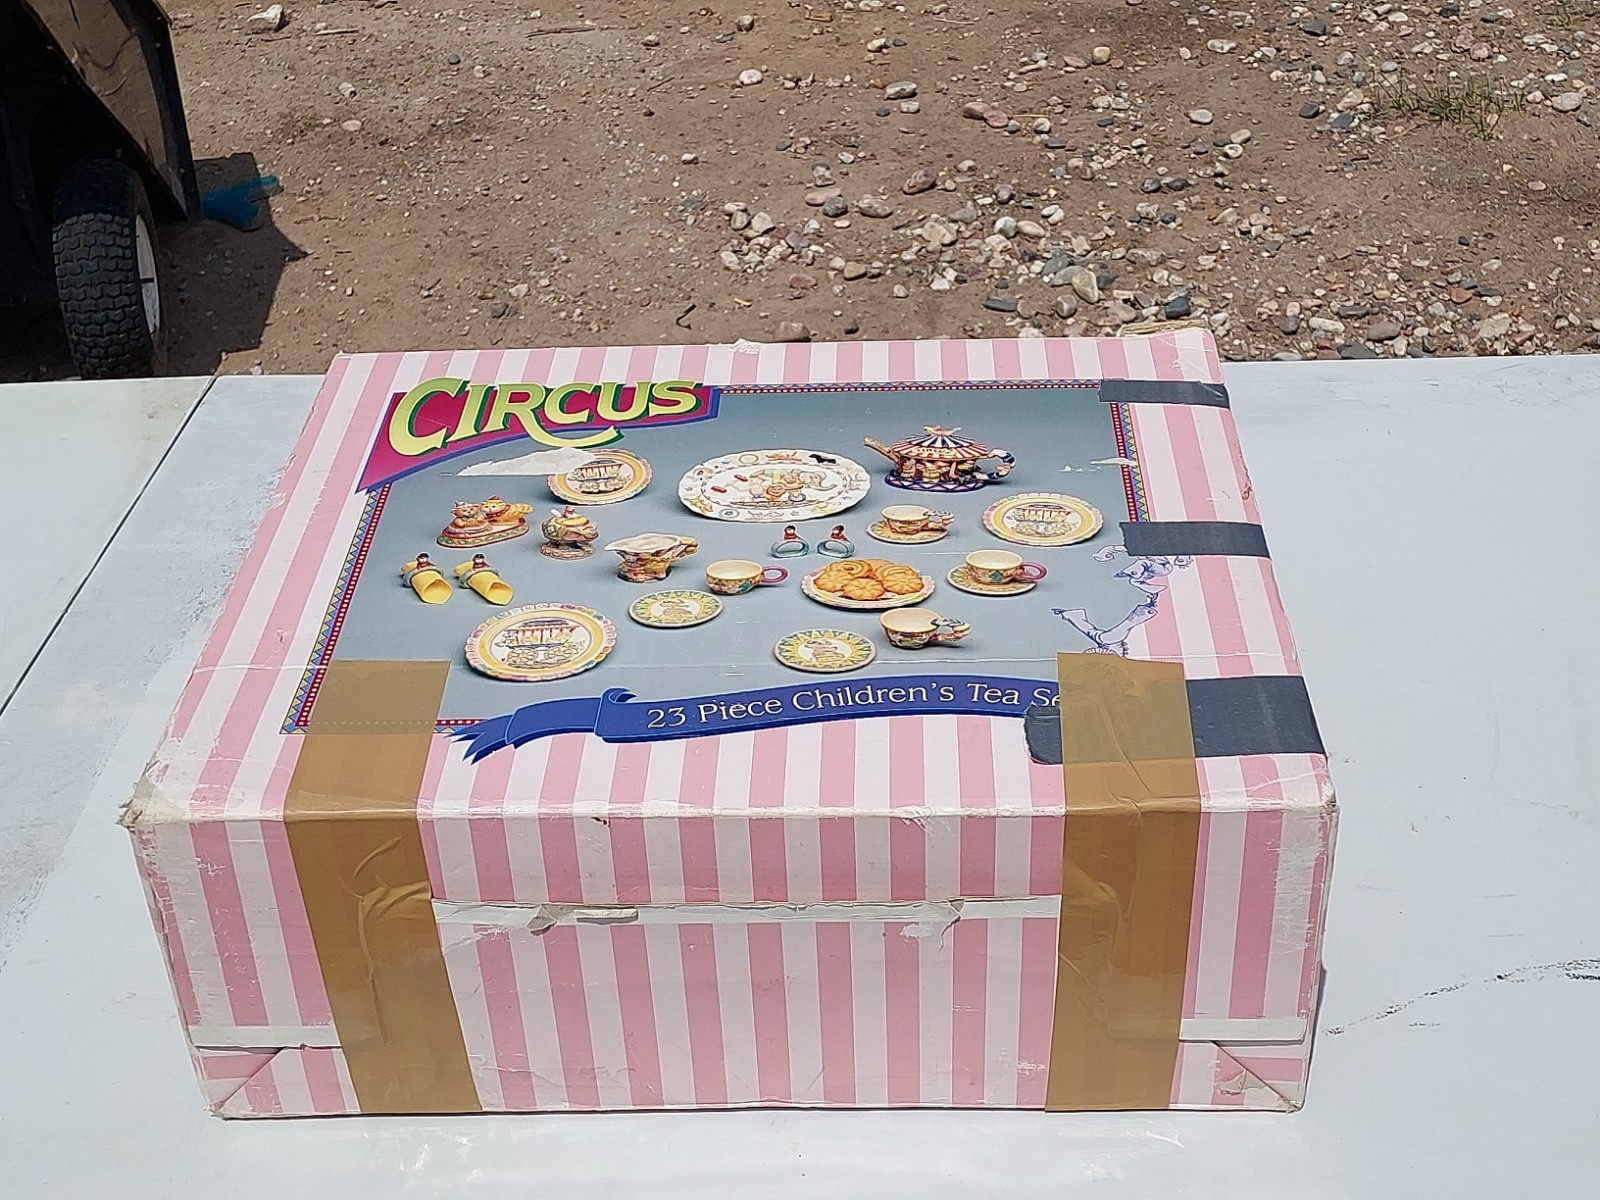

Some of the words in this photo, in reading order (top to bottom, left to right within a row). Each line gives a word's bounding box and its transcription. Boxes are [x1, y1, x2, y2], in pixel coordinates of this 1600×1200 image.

[388, 377, 703, 456] CIRCUS
[647, 706, 686, 729] 23
[697, 698, 783, 723] Piece
[792, 685, 954, 710] Children's
[966, 682, 1020, 705] Tea
